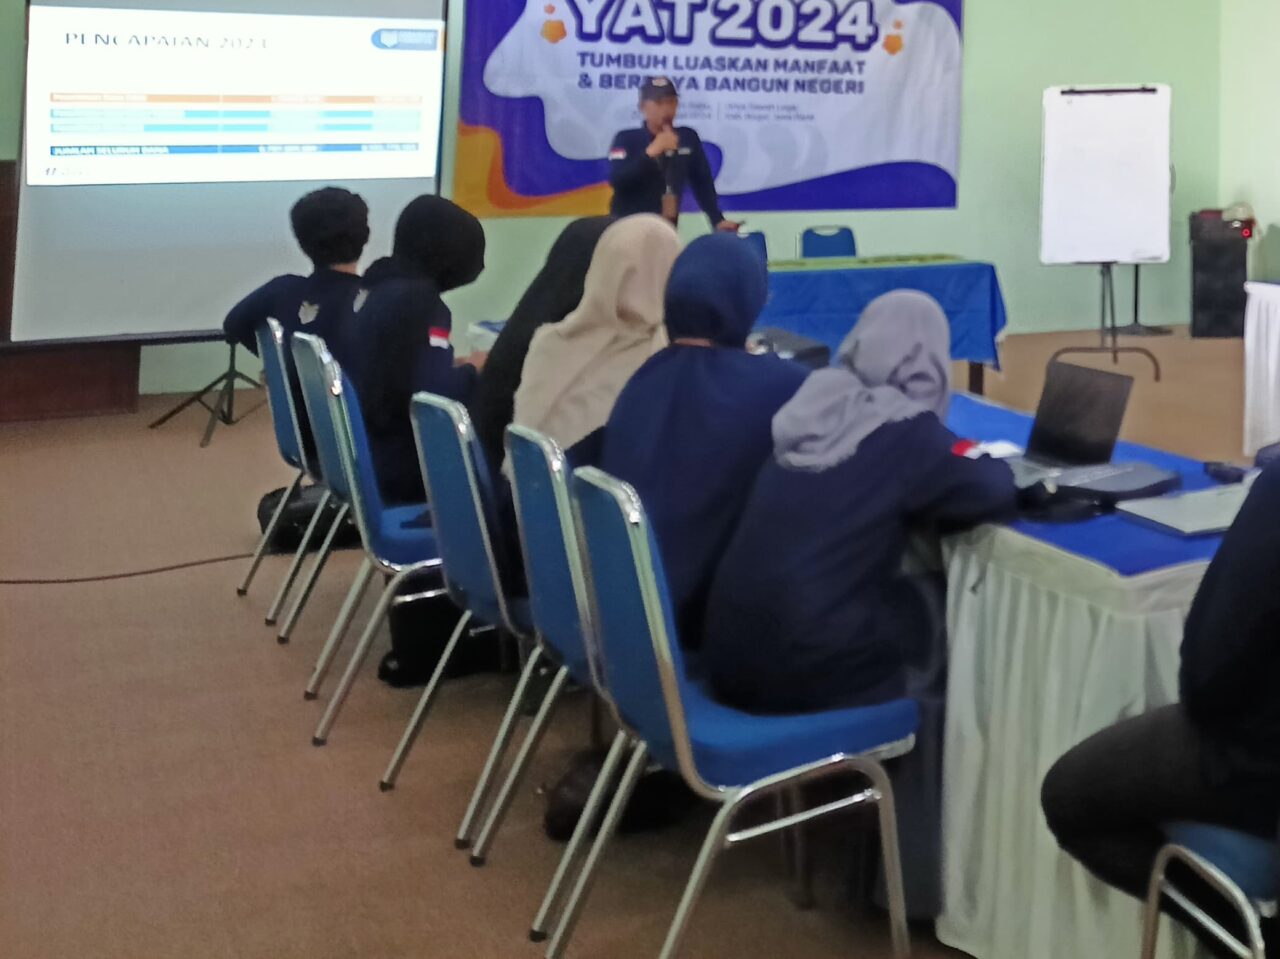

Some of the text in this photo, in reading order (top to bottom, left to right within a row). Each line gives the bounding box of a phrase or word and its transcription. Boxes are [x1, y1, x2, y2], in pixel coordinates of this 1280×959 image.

[577, 52, 866, 76] TUMBUH LUASKAN MANFAAT
[578, 73, 864, 95] & BERYA BANGUN NEGERI
